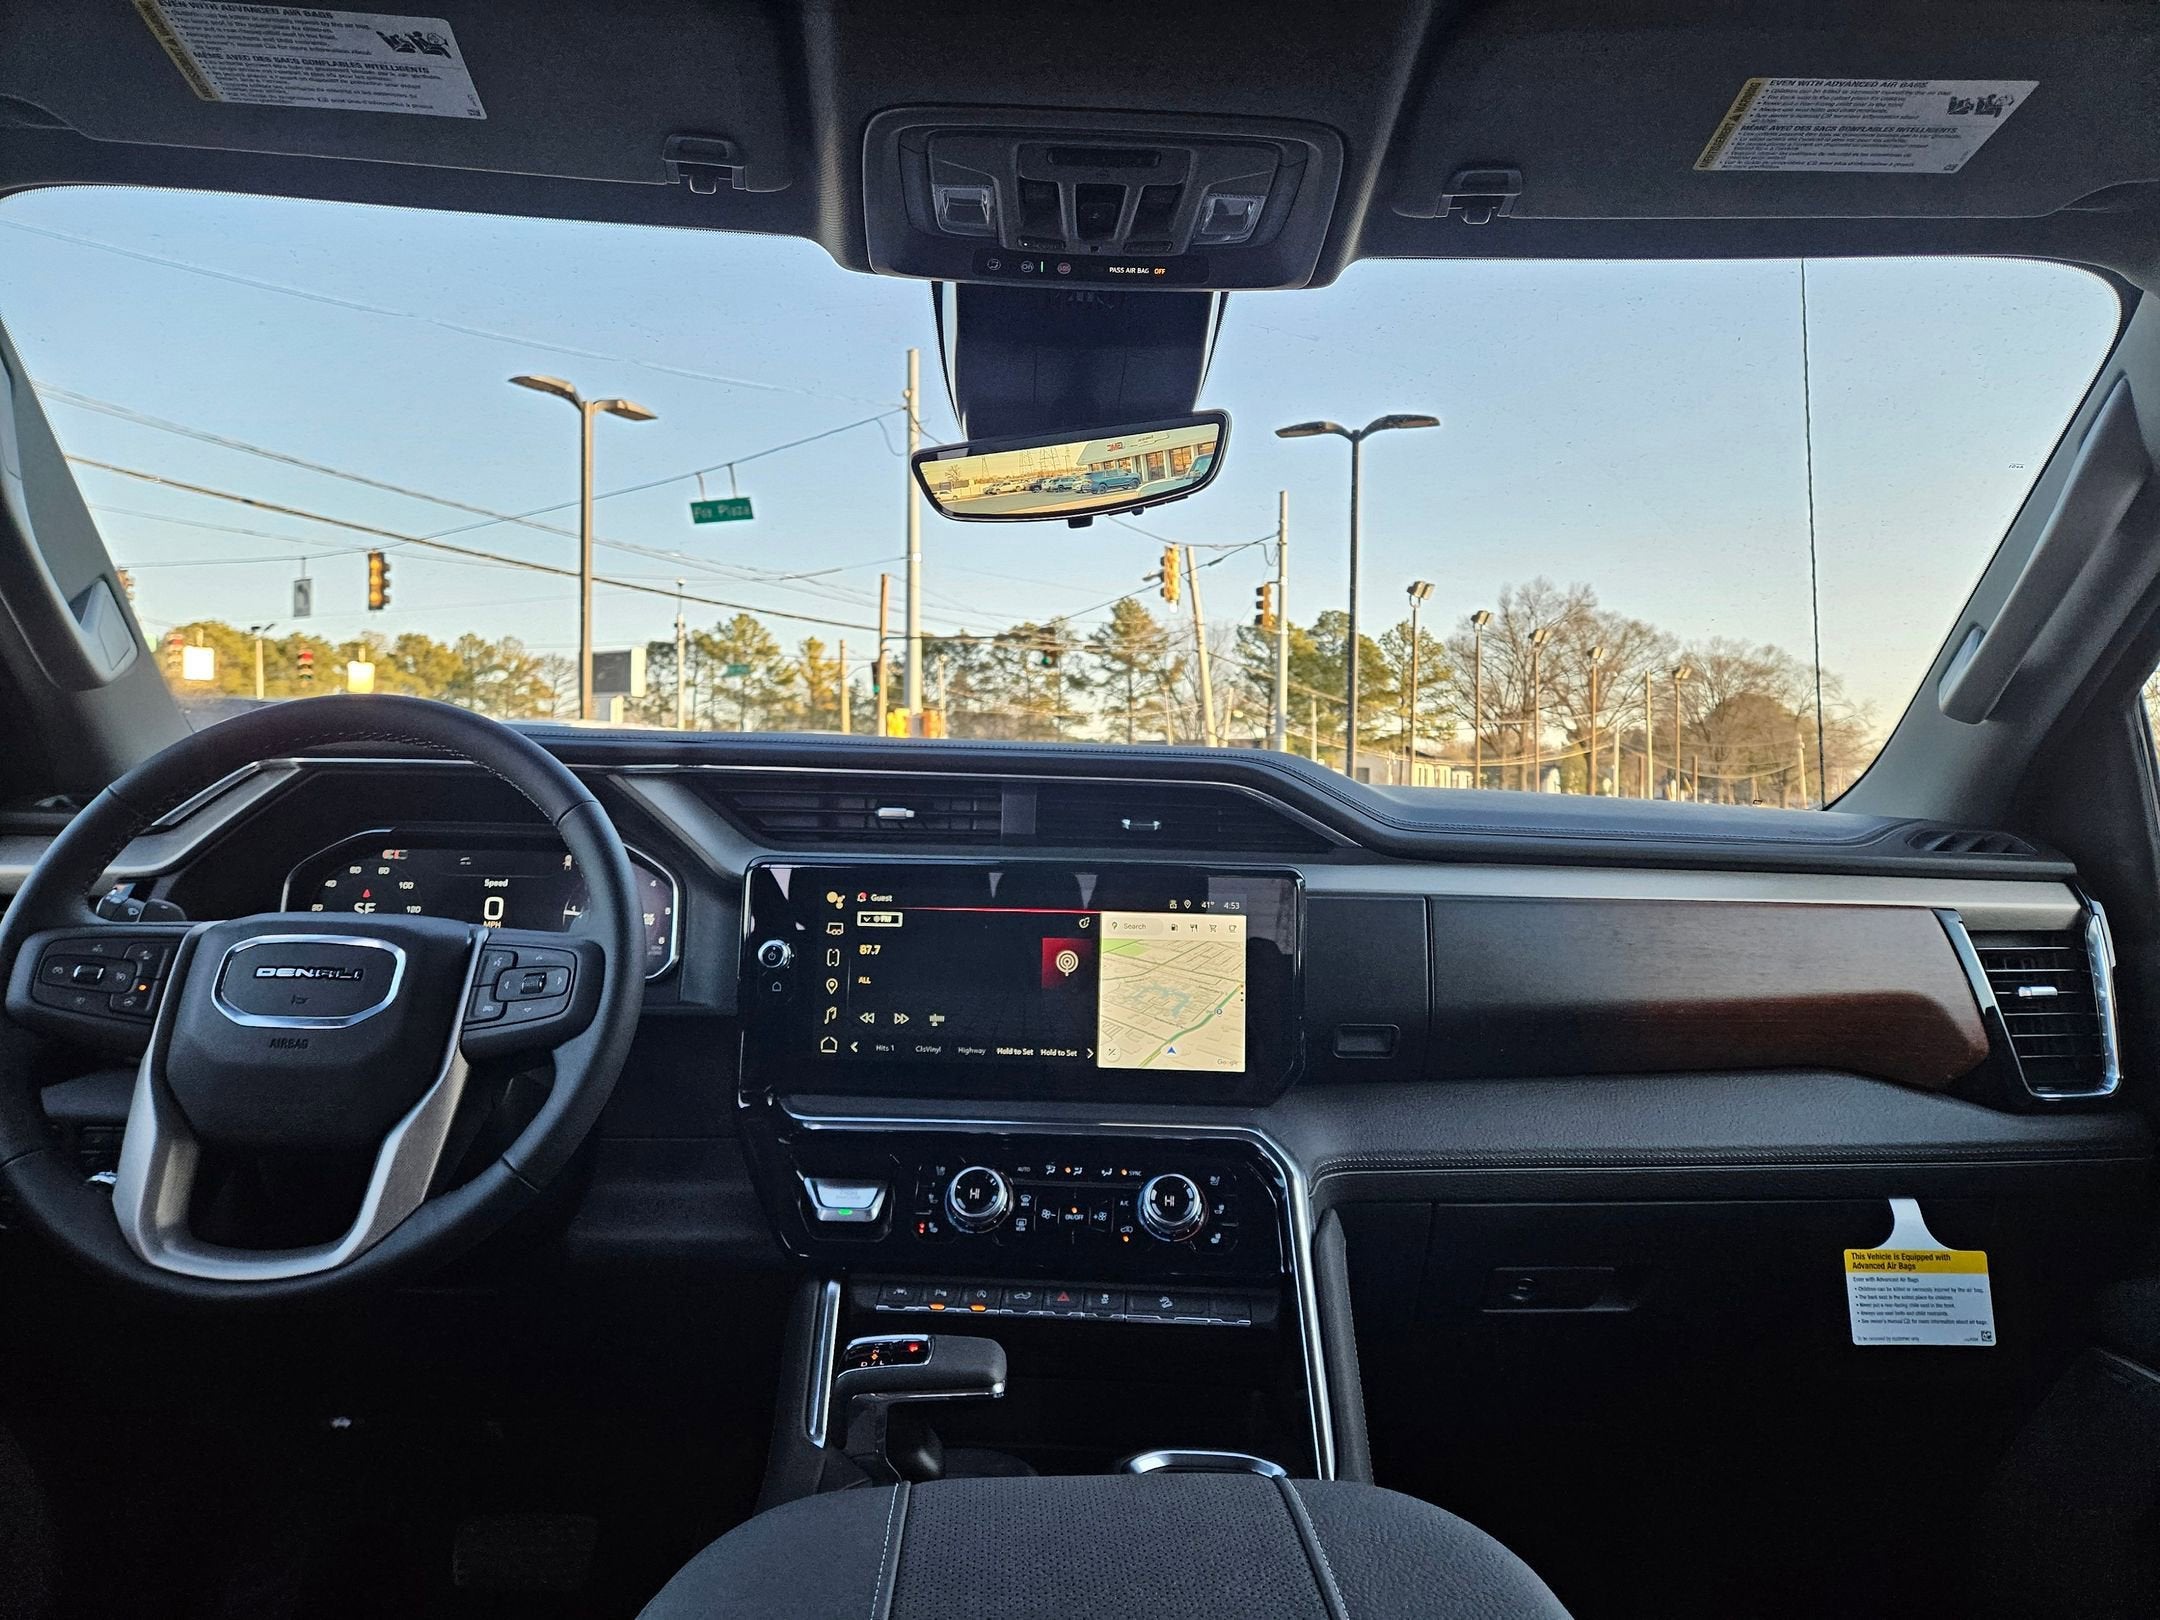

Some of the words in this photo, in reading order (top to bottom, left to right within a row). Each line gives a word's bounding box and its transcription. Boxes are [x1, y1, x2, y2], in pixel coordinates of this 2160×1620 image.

[191, 1, 219, 10] WITH
[221, 4, 281, 15] ADVANCED
[283, 9, 302, 17] AIR
[303, 11, 333, 19] BAGS
[226, 54, 251, 62] AVEC
[1824, 80, 1880, 88] ADVANCED
[1813, 125, 1837, 133] SACS
[1109, 266, 1125, 274] PASS
[1126, 266, 1136, 274] AIR
[1154, 267, 1166, 275] OFF
[399, 881, 415, 890] 100
[485, 879, 509, 888] Speed
[871, 894, 893, 902] Guest
[484, 896, 505, 921] 0
[1201, 901, 1214, 909] 41°
[1224, 901, 1240, 910] 4:53
[483, 921, 502, 929] MPH
[1123, 922, 1146, 931] Search
[860, 944, 882, 955] 87.7
[256, 966, 364, 981] DENALI
[858, 976, 873, 985] ALL
[269, 1039, 309, 1050] AIRBAG
[875, 1043, 889, 1052] Hits
[915, 1045, 941, 1055] ClsVinyl
[957, 1046, 987, 1056] Highway
[996, 1046, 1012, 1055] Hold
[1013, 1047, 1020, 1055] to
[1021, 1047, 1034, 1056] Set
[1040, 1047, 1056, 1056] Hold
[1058, 1048, 1065, 1056] to
[1066, 1048, 1078, 1057] Set
[969, 1187, 980, 1200] HI
[1164, 1195, 1175, 1207] HI
[1851, 1252, 1865, 1261] This
[1867, 1253, 1892, 1262] Vehicle
[1893, 1253, 1900, 1262] is
[1901, 1253, 1934, 1263] Equipped
[1935, 1254, 1951, 1262] with
[1852, 1262, 1885, 1270] Advanced
[1887, 1262, 1897, 1270] Air
[1899, 1263, 1916, 1271] Bags
